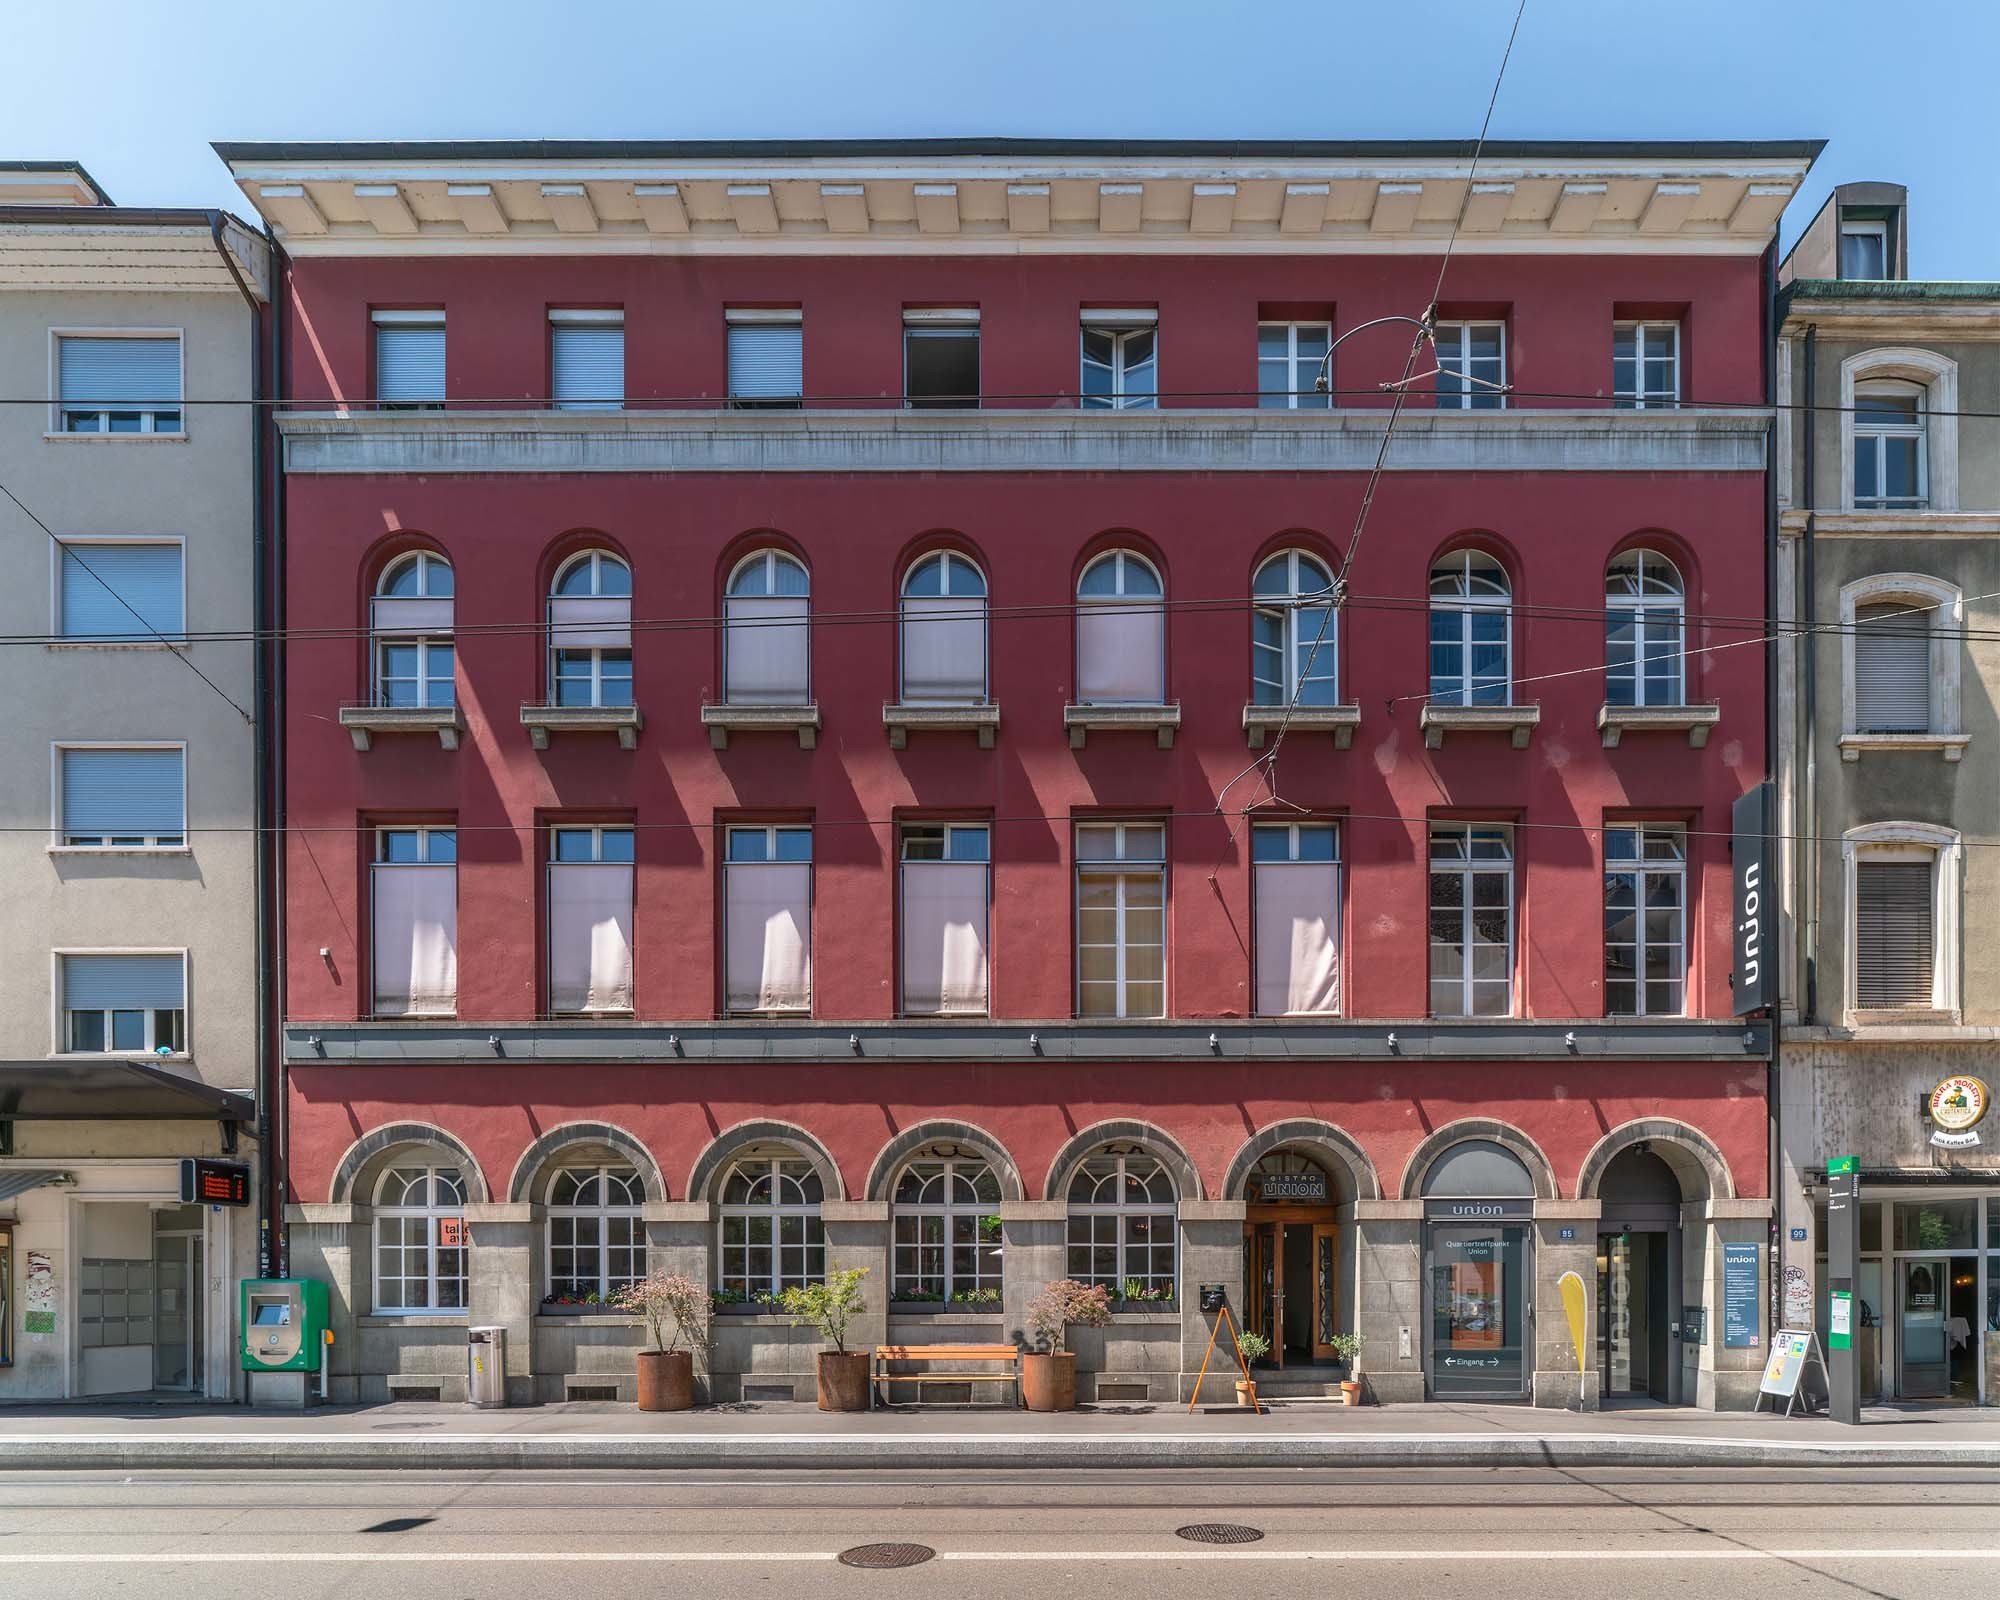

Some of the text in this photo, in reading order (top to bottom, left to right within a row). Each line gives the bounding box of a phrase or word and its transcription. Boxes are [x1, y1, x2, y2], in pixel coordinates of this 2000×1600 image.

[1739, 862, 1759, 986] union
[1933, 1080, 1980, 1107] BIRRA MORETTI
[1264, 1182, 1323, 1196] UNION
[1453, 1201, 1504, 1215] union
[1793, 1230, 1804, 1238] 99
[1446, 1240, 1510, 1248] Quartiertreffpunkt
[1726, 1255, 1756, 1263] union
[1457, 1358, 1485, 1367] Eingang
